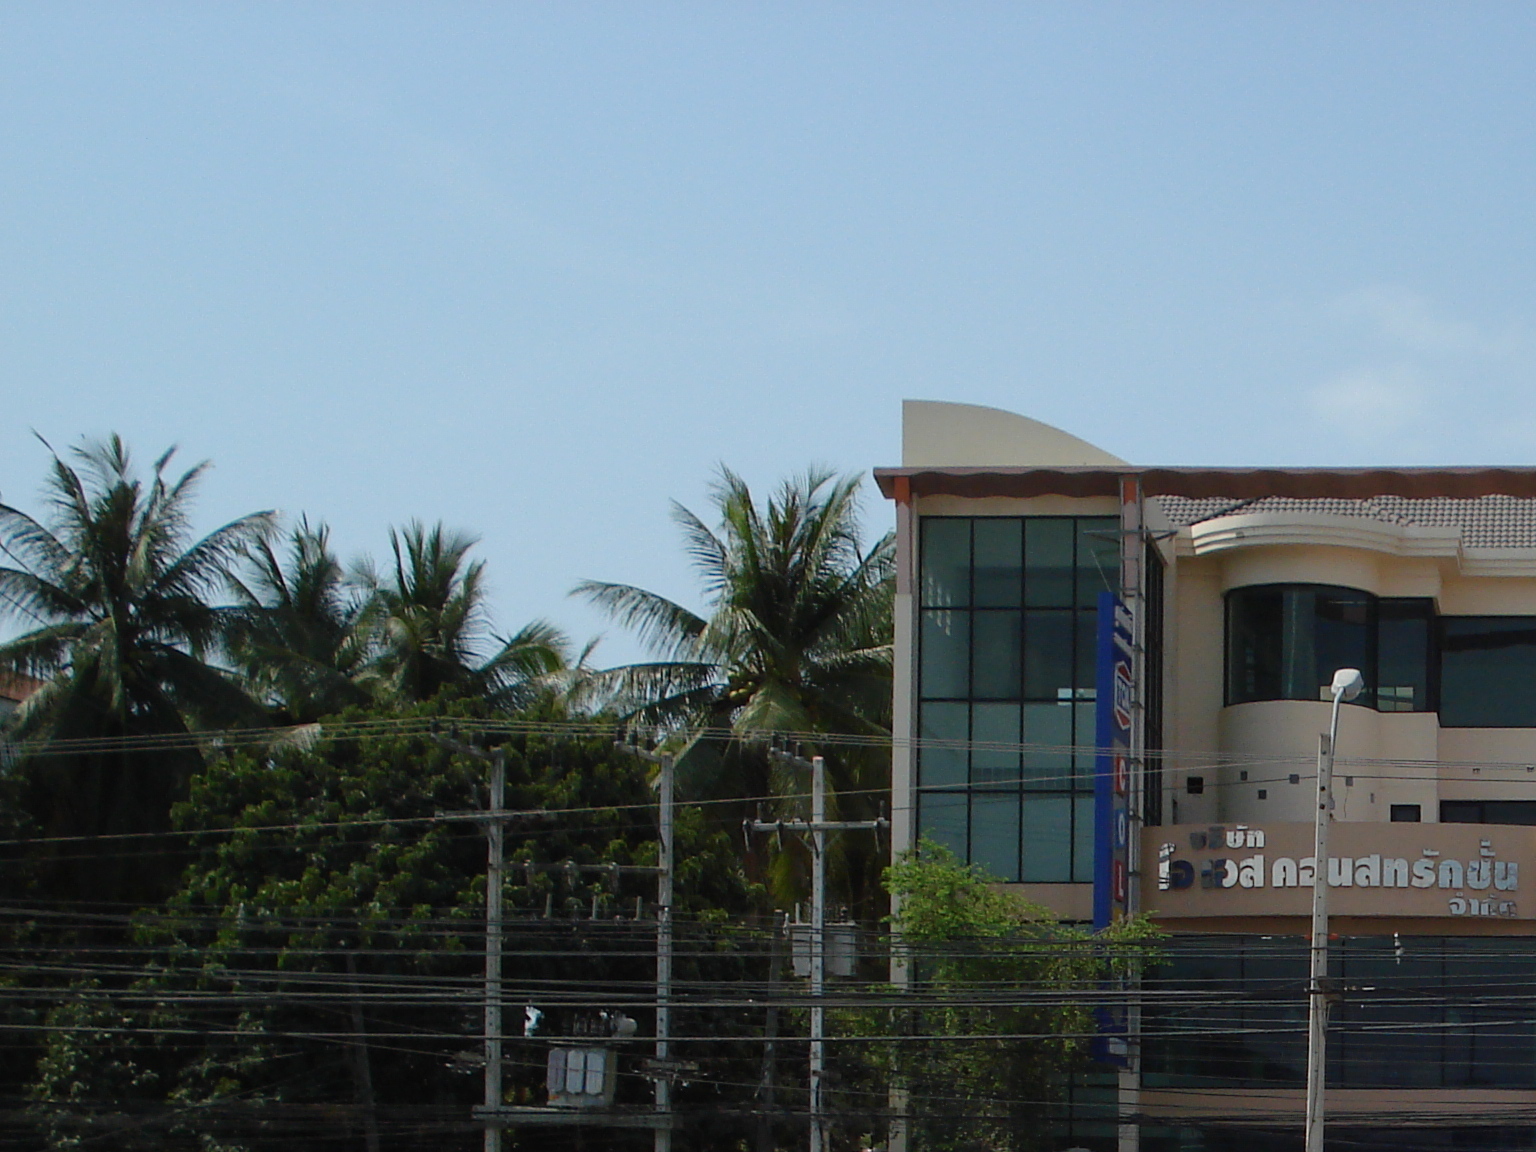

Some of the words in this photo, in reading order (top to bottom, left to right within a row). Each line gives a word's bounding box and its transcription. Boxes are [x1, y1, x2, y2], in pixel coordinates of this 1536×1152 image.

[1190, 825, 1266, 850] บริษัท
[1159, 842, 1195, 891] โอ
[1201, 854, 1265, 889] เอส
[1448, 892, 1518, 917] จำกัด
